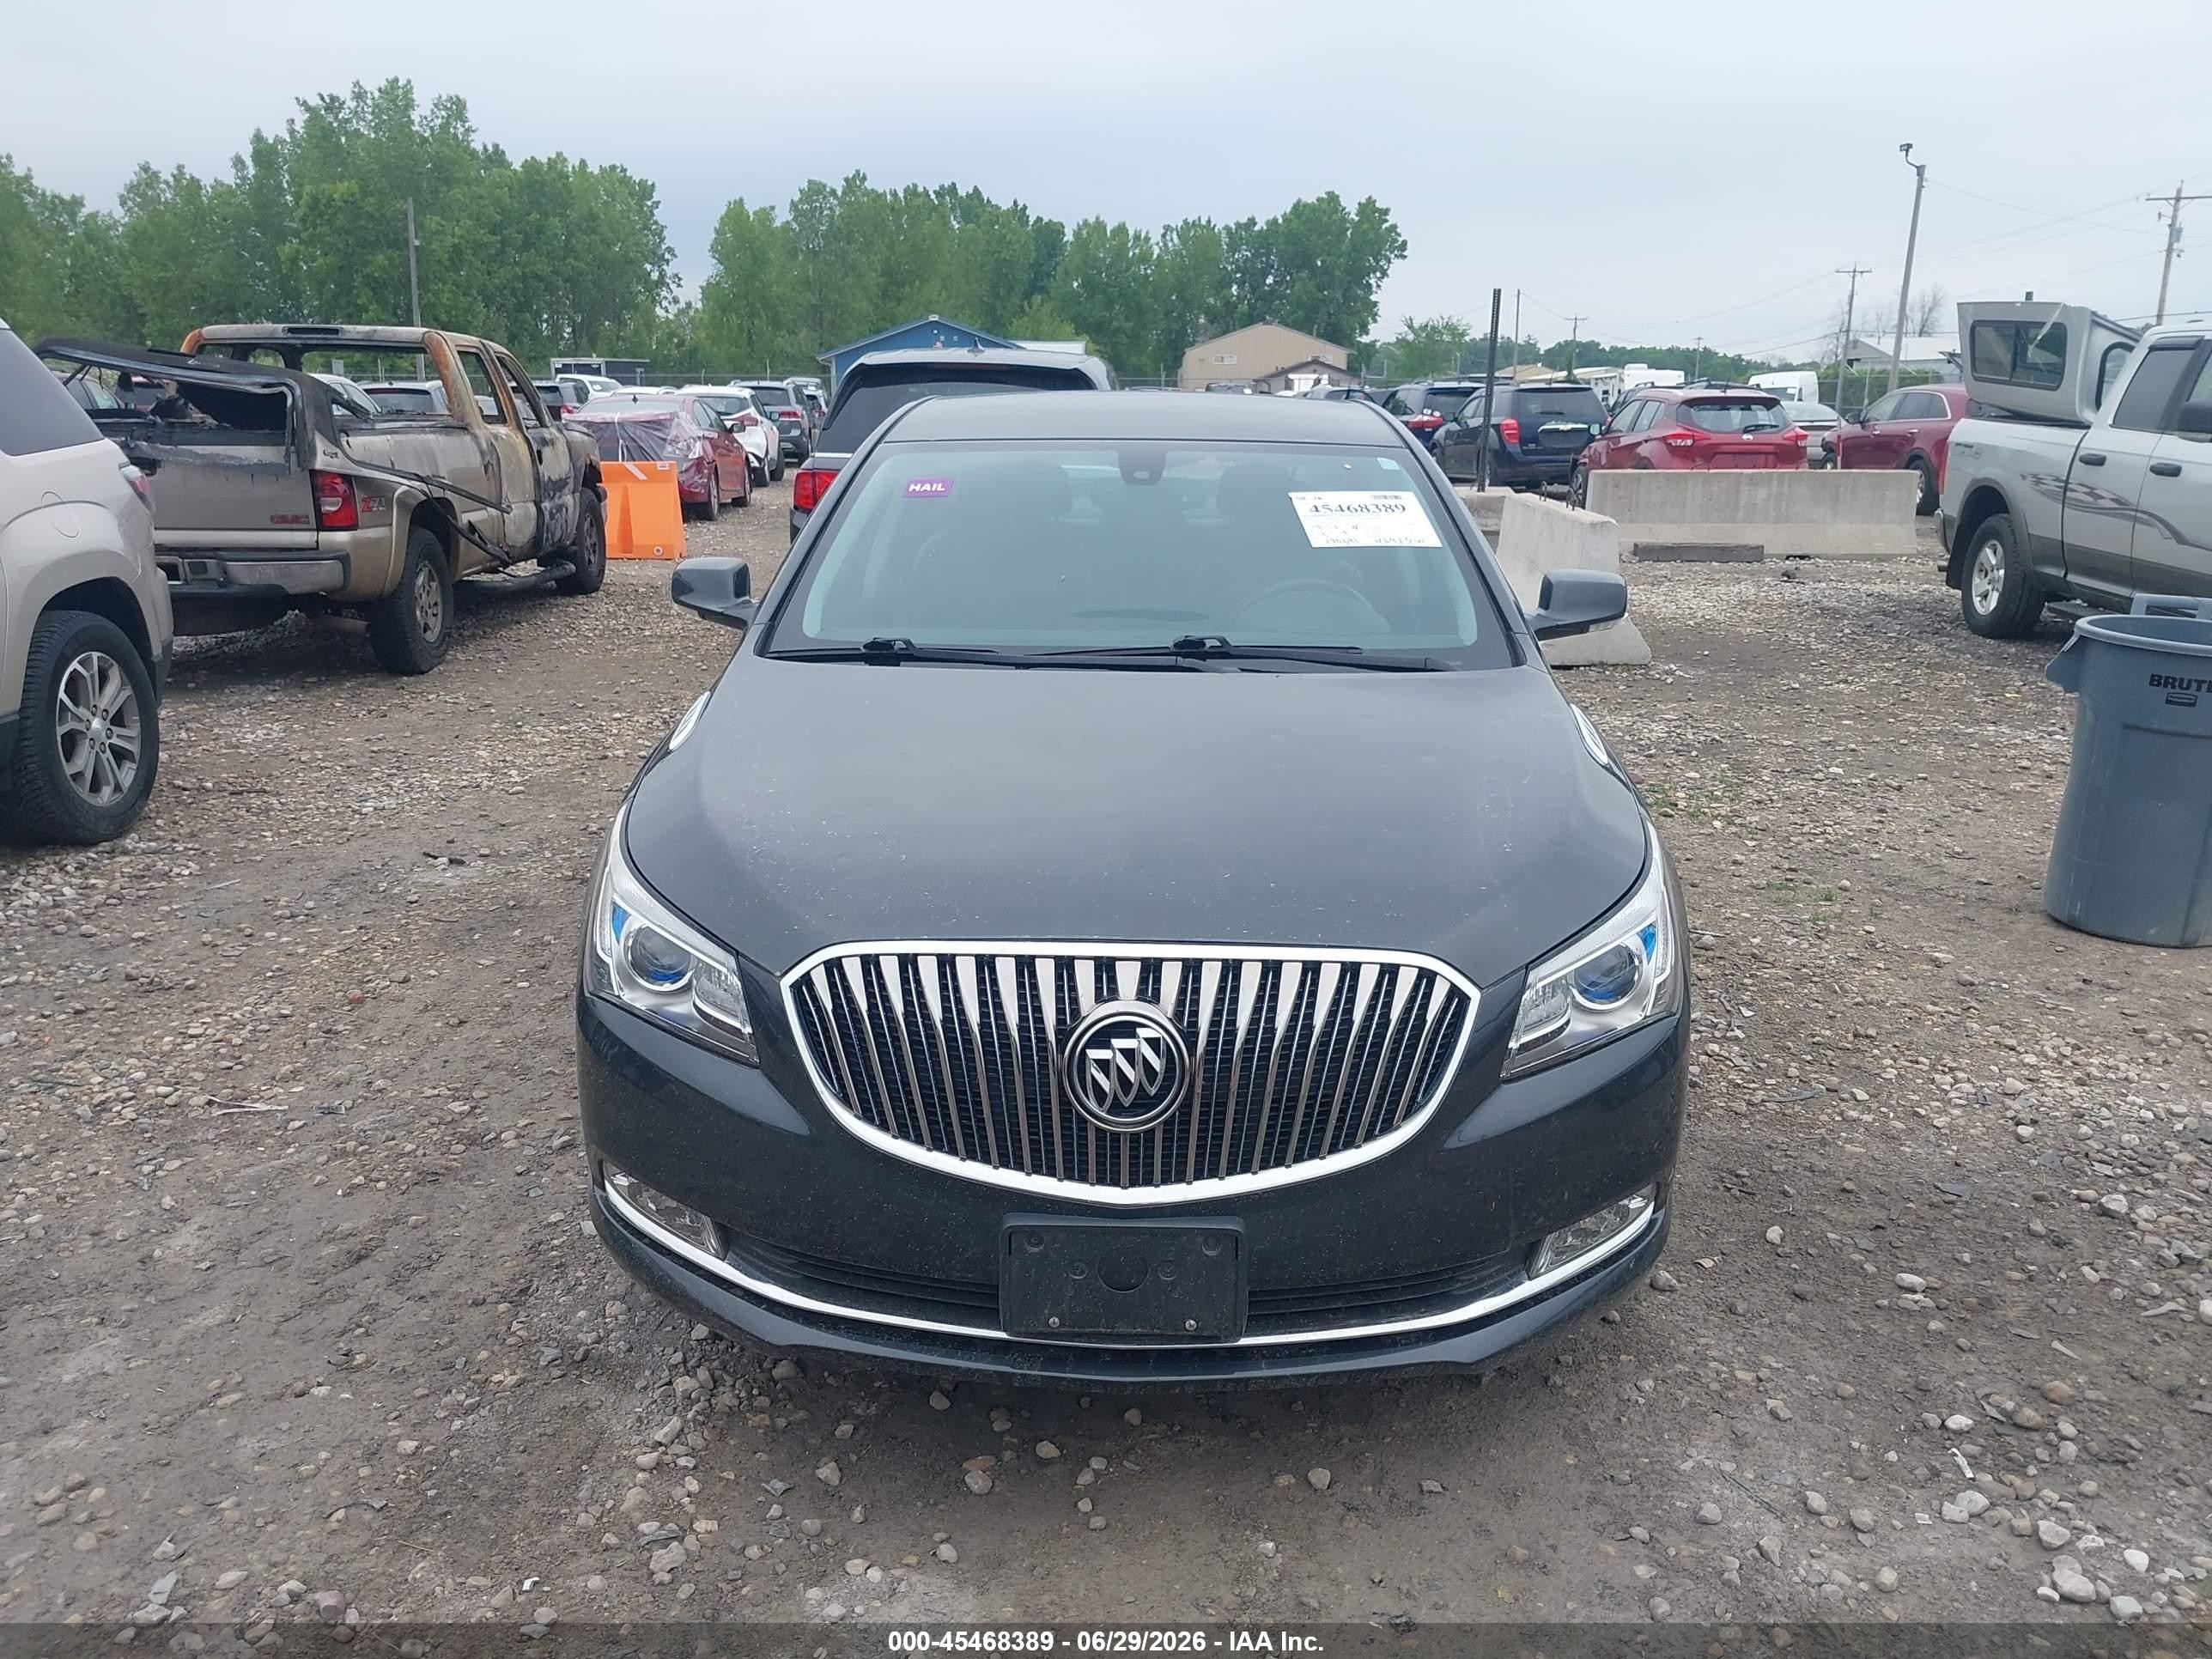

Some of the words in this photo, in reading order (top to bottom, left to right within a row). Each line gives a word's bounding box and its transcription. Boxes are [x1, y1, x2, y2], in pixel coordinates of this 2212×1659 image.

[908, 483, 945, 492] HAIL
[362, 495, 386, 513] Z71
[1310, 503, 1407, 514] 45468389
